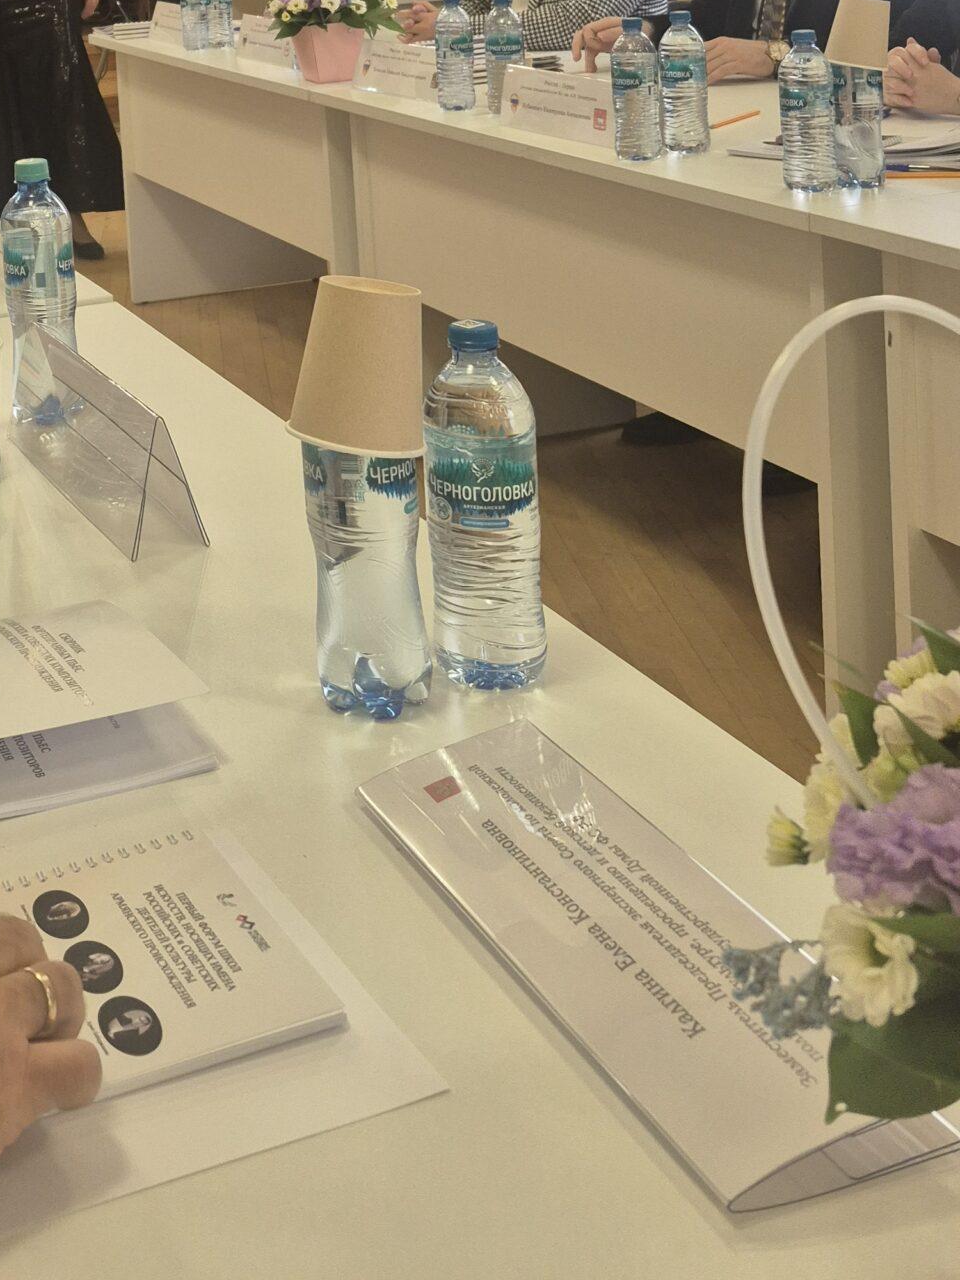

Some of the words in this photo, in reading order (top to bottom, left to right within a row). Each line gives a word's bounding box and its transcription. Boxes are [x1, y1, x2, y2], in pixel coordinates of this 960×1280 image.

[430, 473, 535, 503] ЧЕРНОГОЛОВКА
[12, 734, 45, 778] ПОЗИТОРОВ
[495, 766, 559, 821] безопасности
[482, 819, 590, 926] Константиновна
[573, 858, 642, 921] экспертного
[608, 844, 647, 873] Думы
[176, 892, 205, 922] ПЕРВЫЙ
[198, 921, 224, 950] ФОРУМ
[217, 948, 242, 973] ШКОЛ
[607, 865, 689, 938] просвещению
[640, 873, 731, 951] сударственной
[110, 892, 149, 939] АРМЯНСКОГО
[143, 938, 197, 1009] ПРОИСХОЖДЕНИЯ
[135, 906, 171, 944] ДЕЯТЕЛЕЙ
[162, 943, 198, 984] КУЛЬТУРЫ
[142, 891, 183, 939] РОССИЙСКИХ
[180, 944, 221, 992] СОВЕТСКИХ
[181, 922, 217, 962] НОСЯЩИХ
[209, 960, 237, 992] ИМЕНА
[587, 922, 636, 972] Елена
[640, 920, 728, 1002] Председателя
[635, 968, 706, 1039] Калгина
